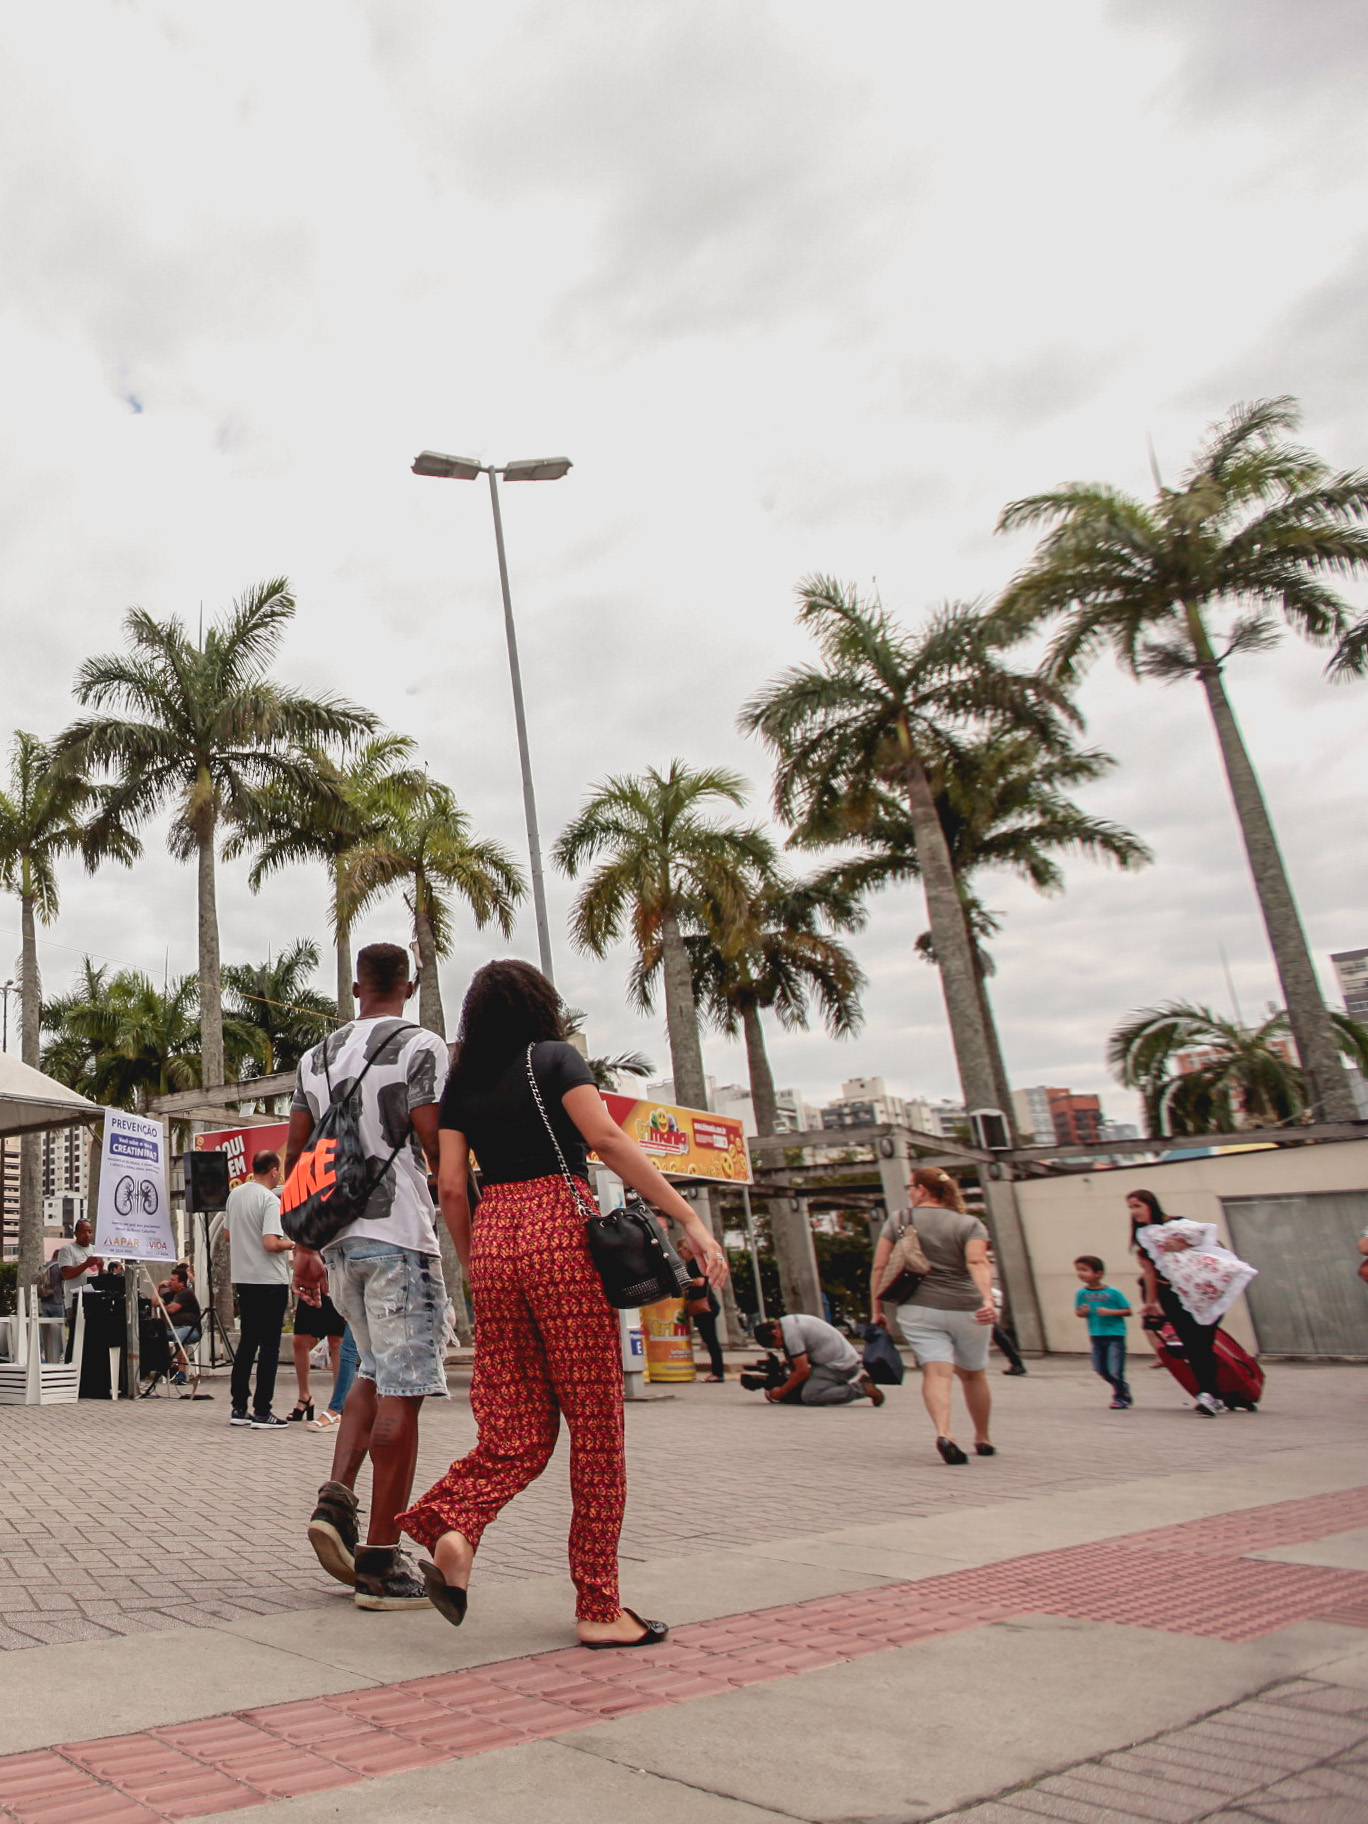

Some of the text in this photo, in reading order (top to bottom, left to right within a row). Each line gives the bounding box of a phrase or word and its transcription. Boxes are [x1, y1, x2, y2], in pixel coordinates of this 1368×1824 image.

[112, 1117, 158, 1137] PREVENÇÃO
[113, 1236, 140, 1248] APAR
[149, 1241, 168, 1250] VIDA
